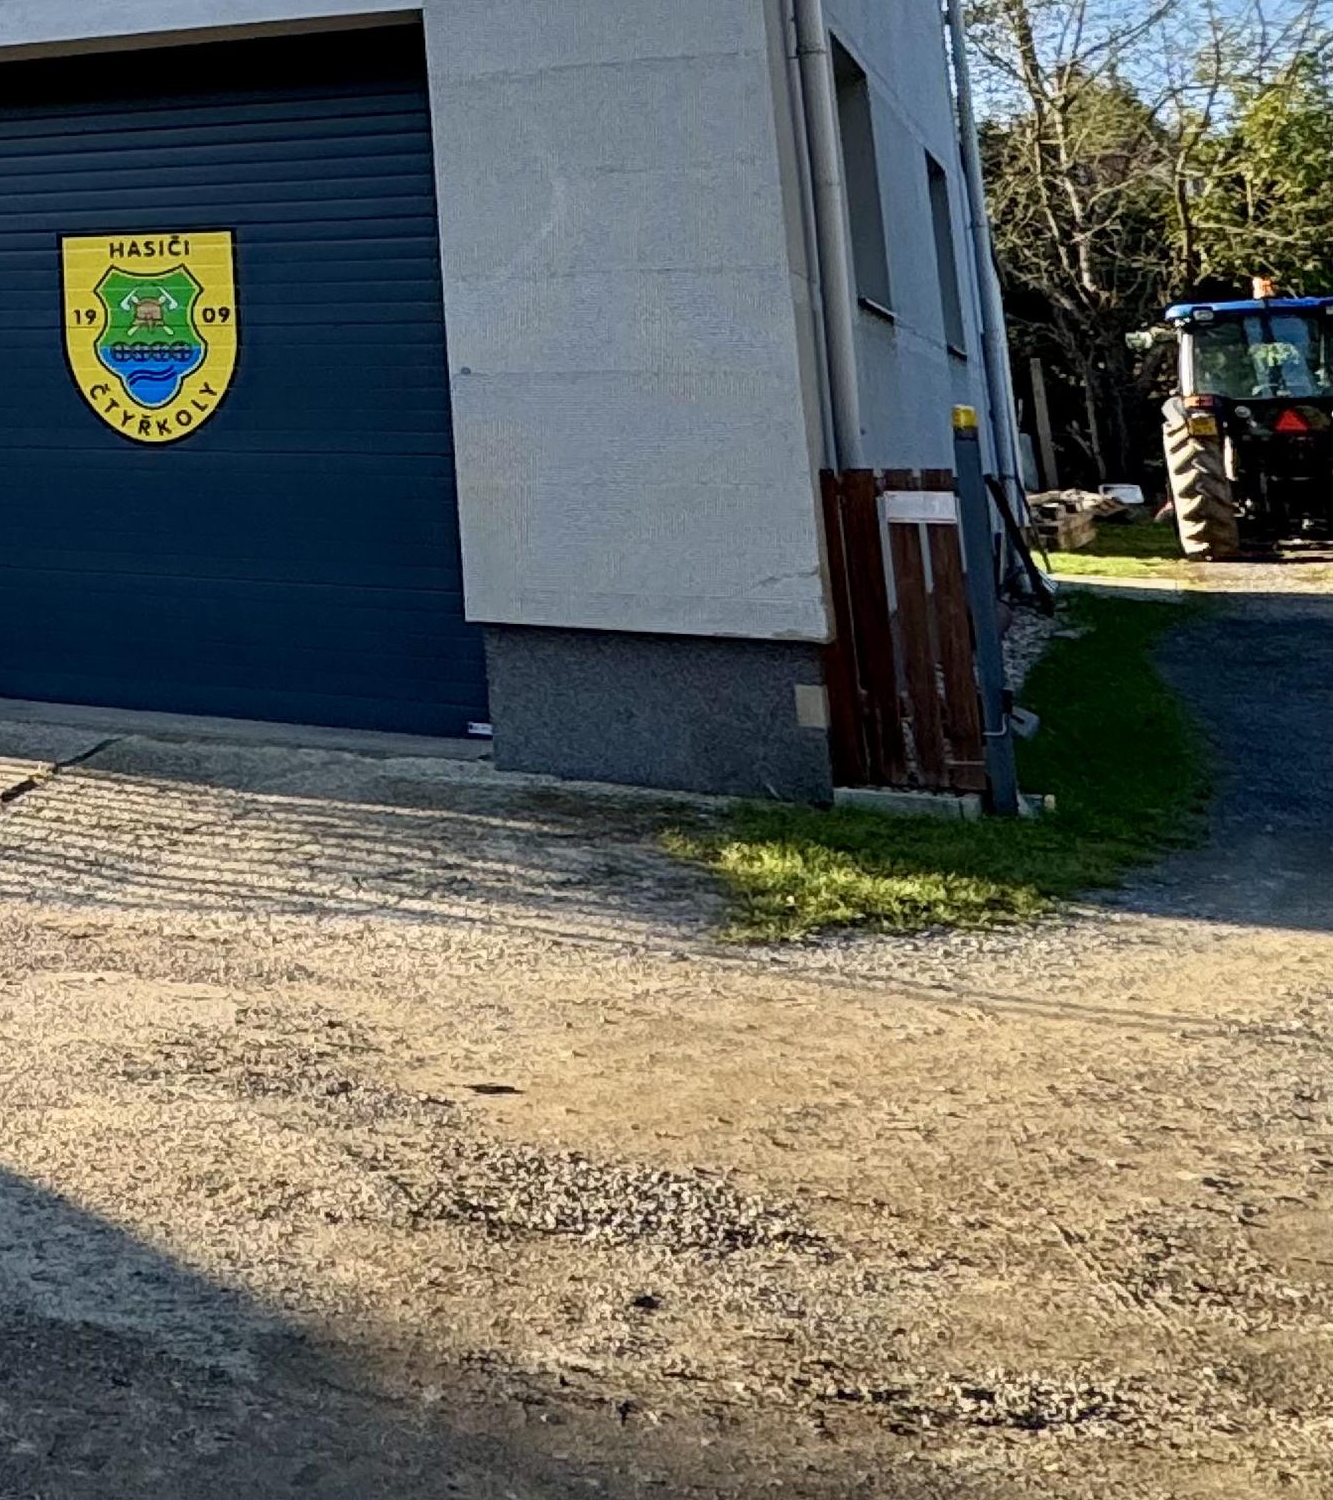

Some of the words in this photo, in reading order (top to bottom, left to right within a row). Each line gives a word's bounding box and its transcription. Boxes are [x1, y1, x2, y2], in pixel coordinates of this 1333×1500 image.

[109, 235, 190, 259] HASIČI
[73, 308, 97, 326] 19
[201, 306, 231, 324] 09
[89, 382, 219, 437] ČTYŘKOLY
